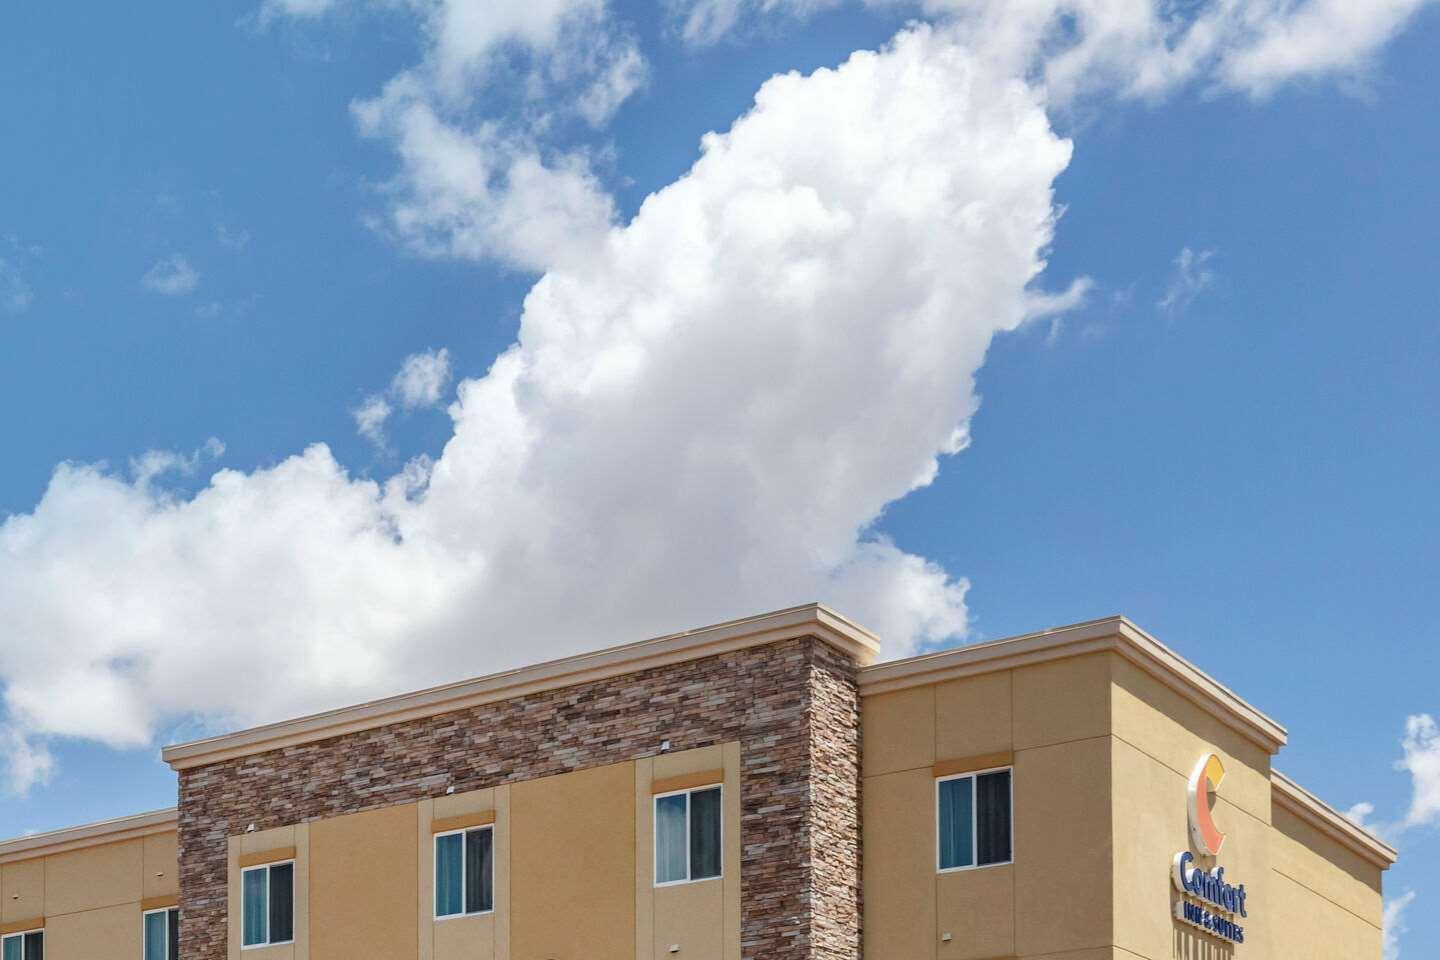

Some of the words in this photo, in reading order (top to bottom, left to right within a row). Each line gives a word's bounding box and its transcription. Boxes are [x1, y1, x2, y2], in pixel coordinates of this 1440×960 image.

[1178, 851, 1247, 918] Comfort
[1184, 901, 1202, 925] INN
[1212, 914, 1244, 943] SUITES
